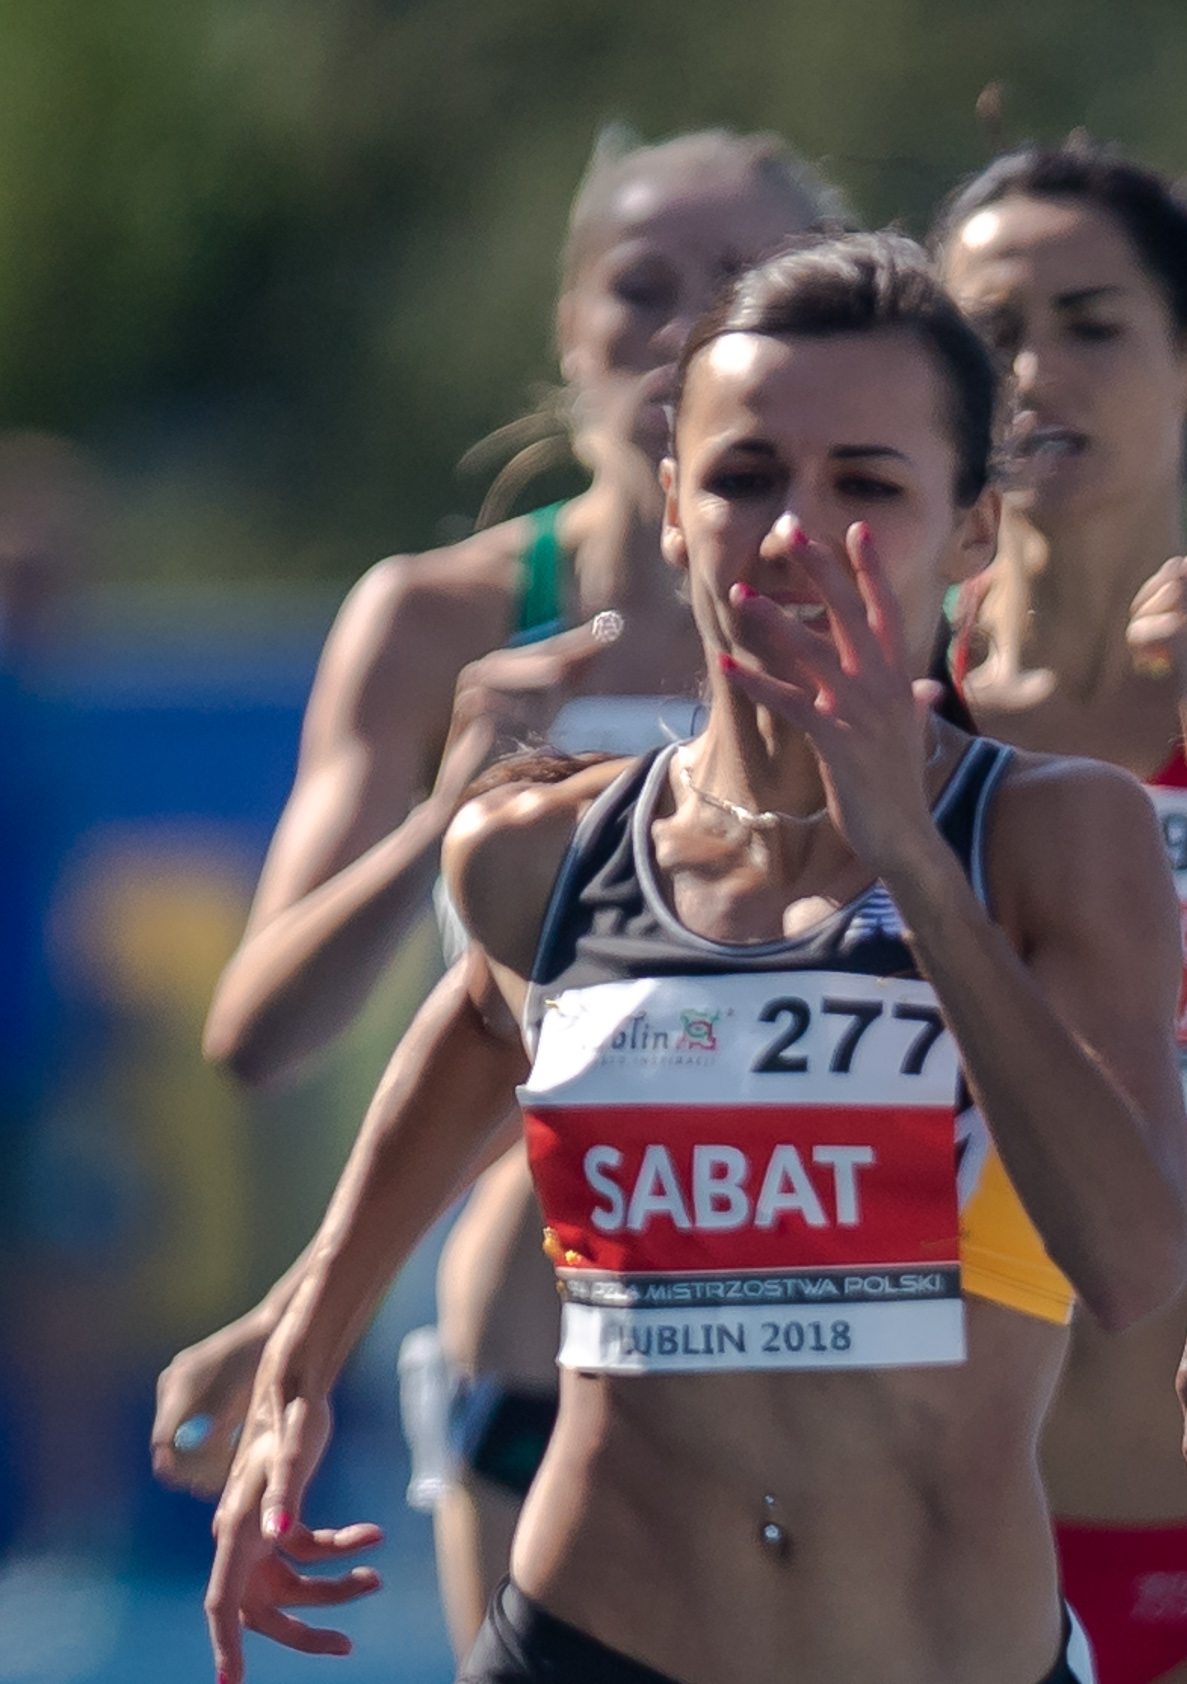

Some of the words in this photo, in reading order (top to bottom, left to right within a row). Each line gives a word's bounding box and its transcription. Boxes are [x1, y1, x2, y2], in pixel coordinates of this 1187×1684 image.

[751, 995, 946, 1076] 277
[583, 1143, 877, 1232] SABAT
[646, 1278, 840, 1300] MISTRZOSTWA
[844, 1273, 942, 1294] POLSKI
[618, 1322, 747, 1356] LUBLIN
[760, 1319, 852, 1352] 2018
